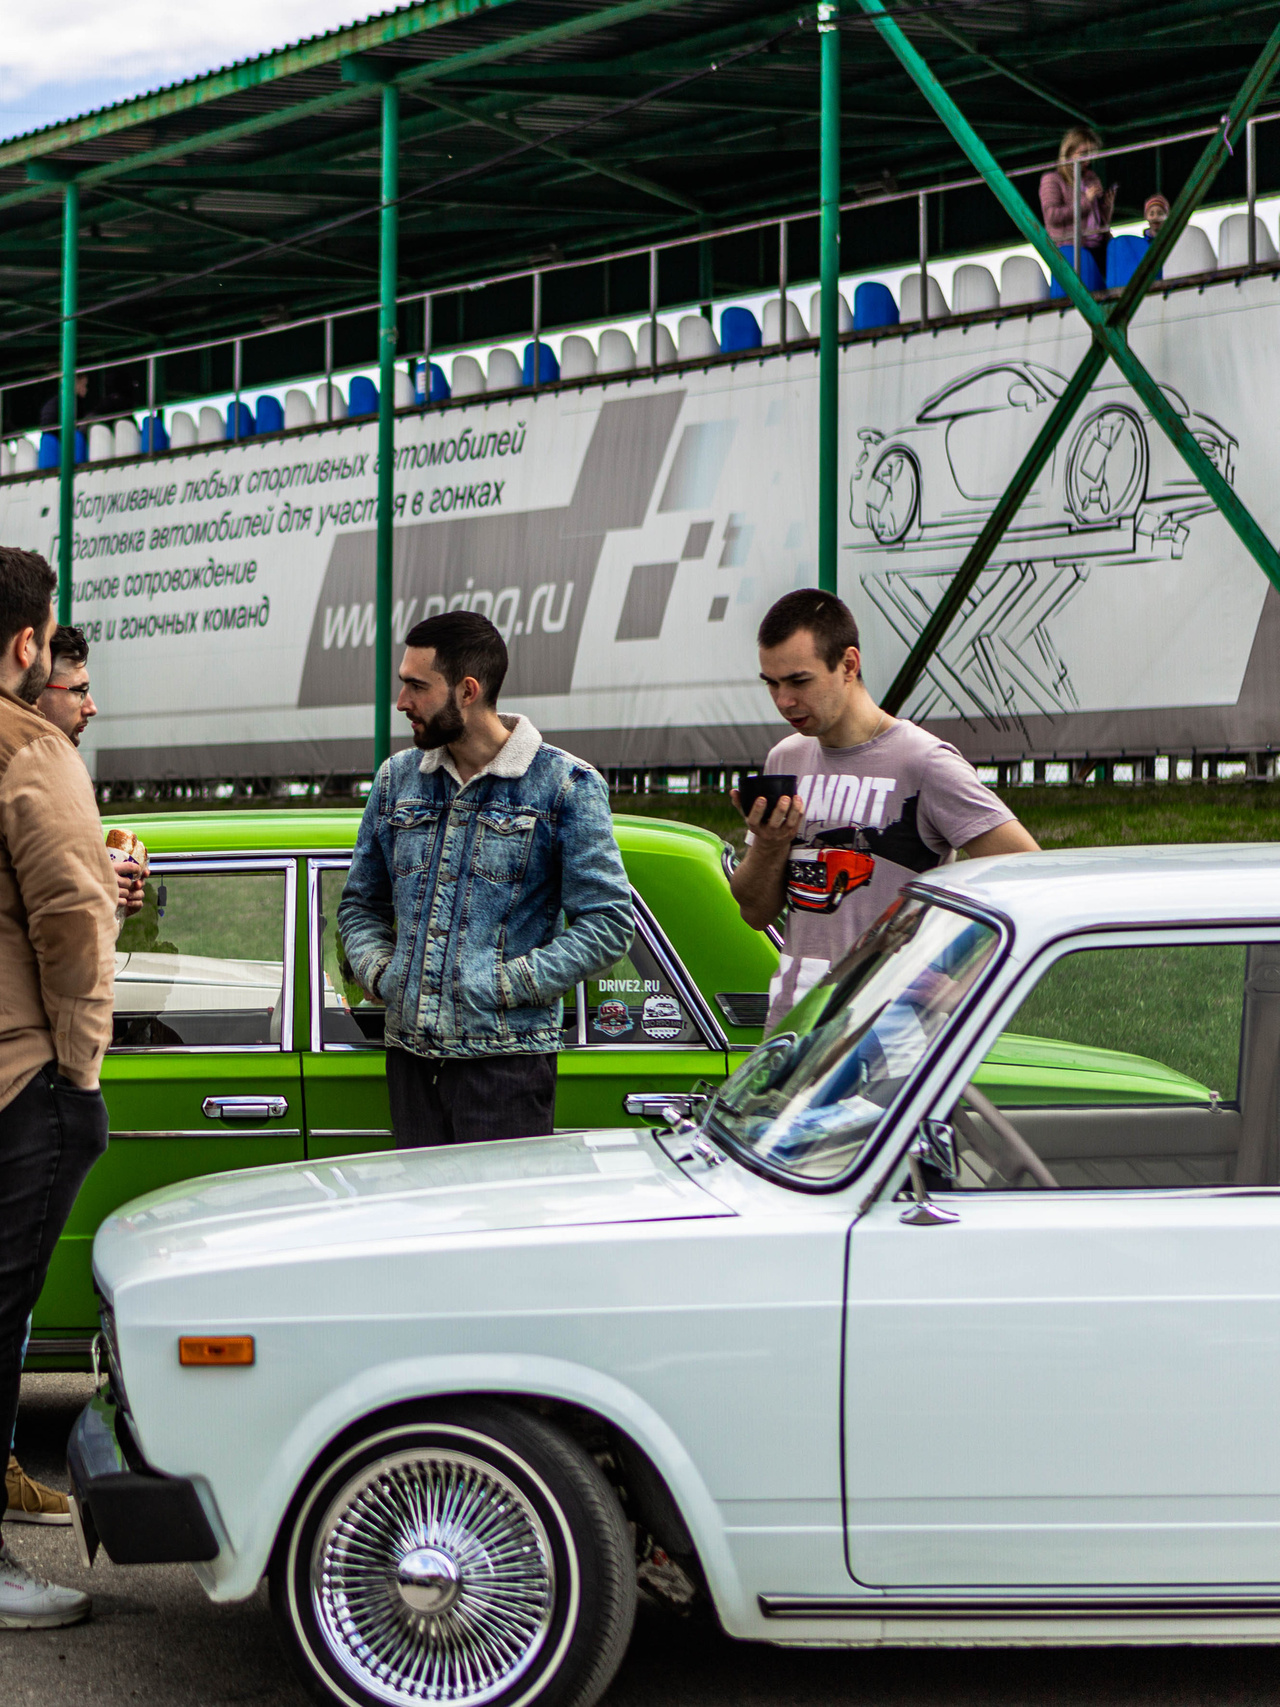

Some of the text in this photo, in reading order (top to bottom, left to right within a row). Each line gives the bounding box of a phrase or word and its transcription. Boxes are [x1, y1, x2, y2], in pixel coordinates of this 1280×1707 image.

[72, 421, 526, 523] бслуживание любых спортивных томобилей
[48, 480, 506, 563] Пдготовка автомобилей для участя в гонках
[123, 558, 258, 601] сопровождение
[106, 619, 117, 641] и
[120, 611, 198, 640] гоночных
[202, 596, 270, 633] команд
[323, 577, 574, 650] wwwing.ru
[598, 979, 661, 993] DRIVE2.RU
